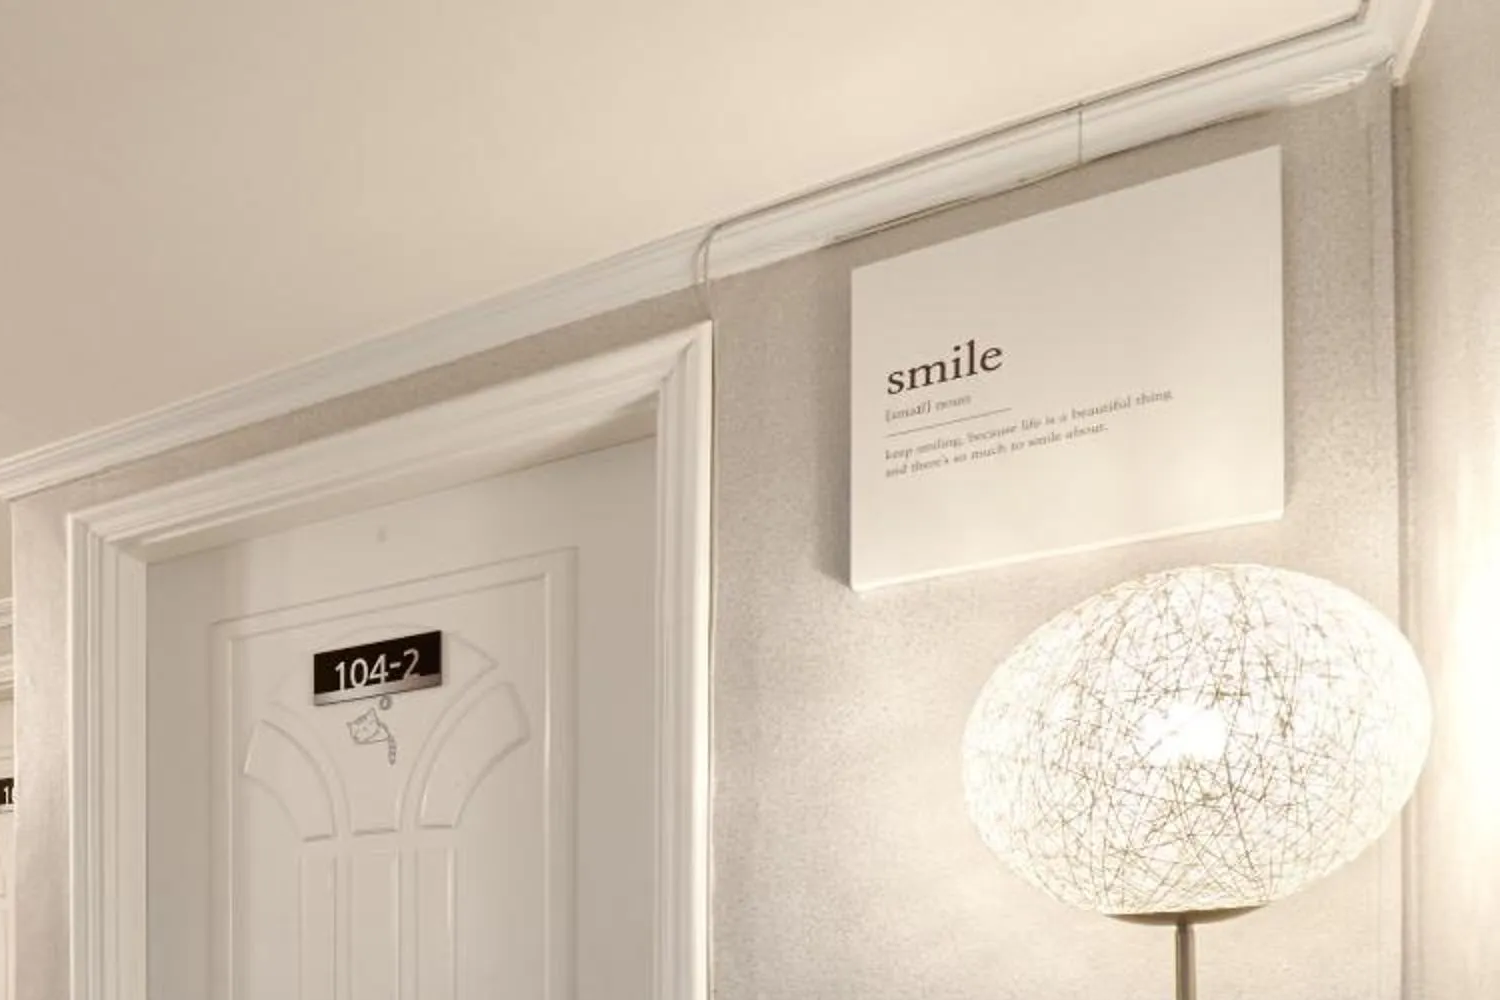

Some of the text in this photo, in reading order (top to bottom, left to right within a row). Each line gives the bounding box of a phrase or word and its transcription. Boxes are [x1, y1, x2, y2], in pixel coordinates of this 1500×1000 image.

[887, 339, 1003, 395] smile
[885, 447, 913, 461] keep
[967, 425, 1017, 443] because
[1021, 417, 1042, 430] life
[1045, 415, 1055, 425] is
[1072, 395, 1131, 420] beautiful
[885, 463, 907, 478] and
[953, 453, 967, 463] so
[971, 443, 1007, 460] much
[1011, 440, 1025, 451] to
[1028, 432, 1061, 447] smile
[335, 648, 419, 693] 104-2
